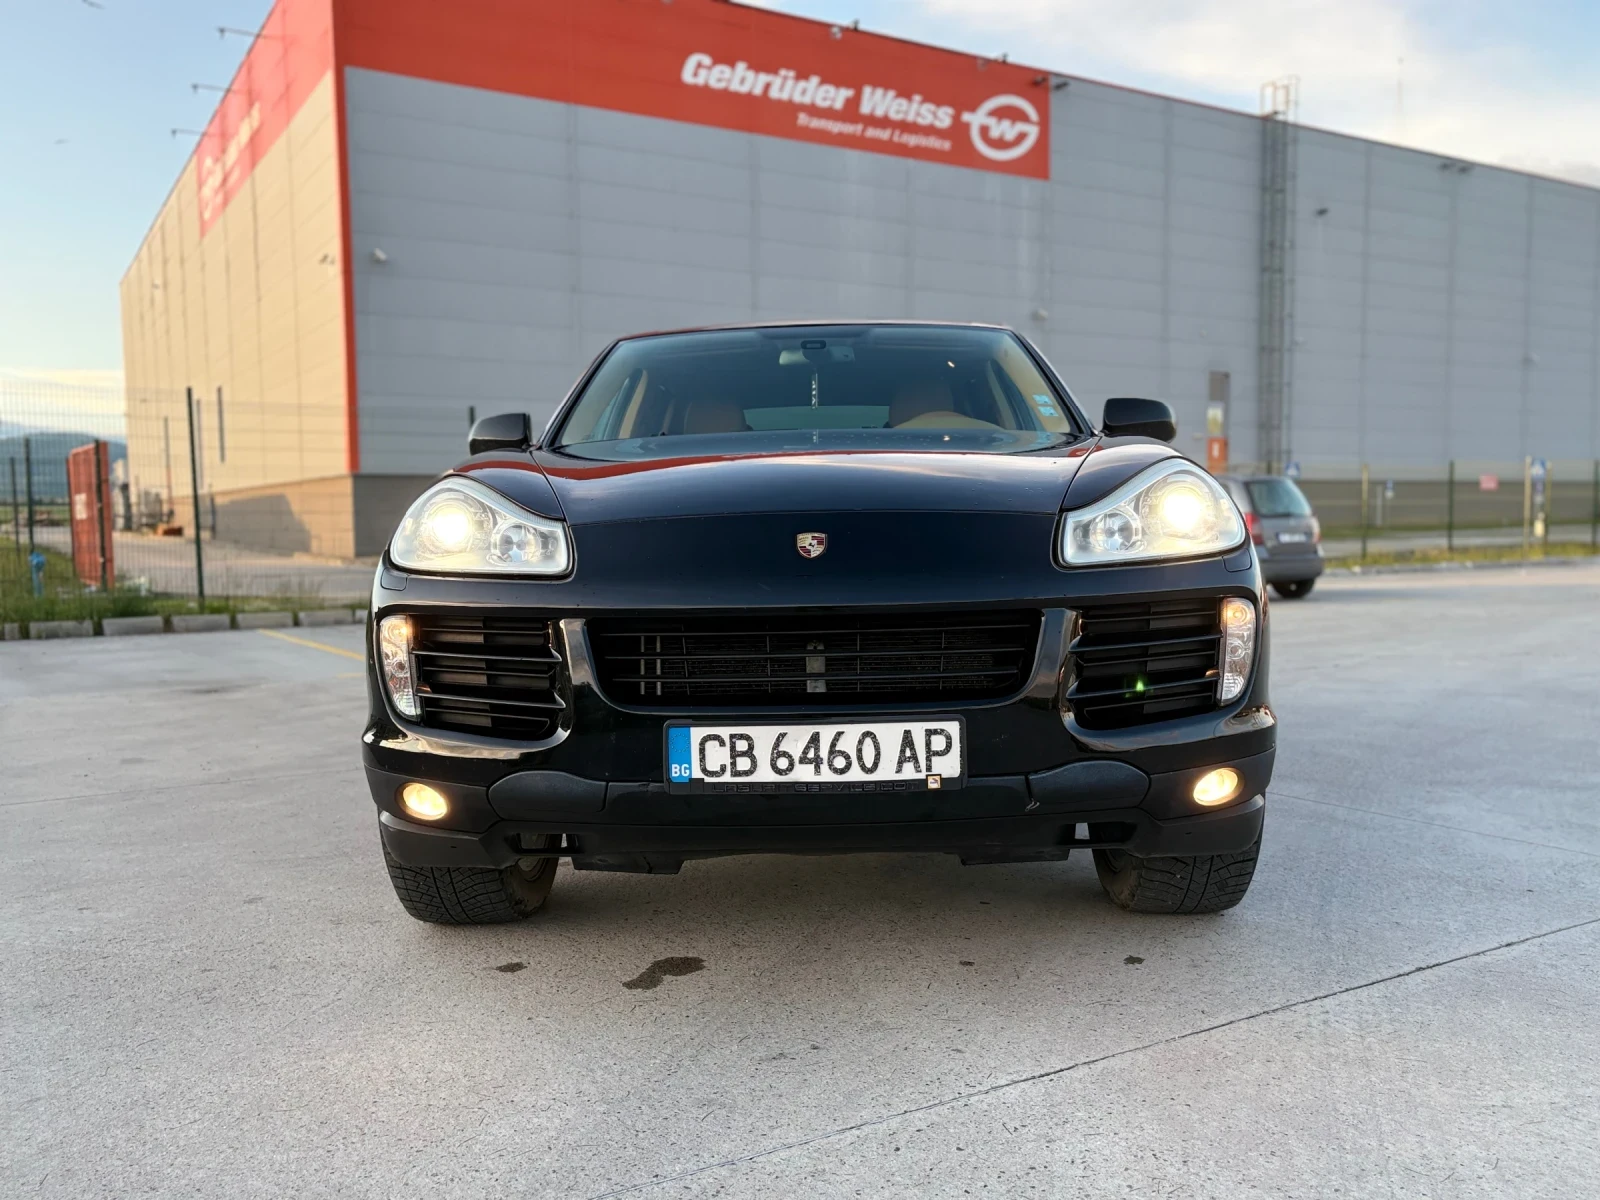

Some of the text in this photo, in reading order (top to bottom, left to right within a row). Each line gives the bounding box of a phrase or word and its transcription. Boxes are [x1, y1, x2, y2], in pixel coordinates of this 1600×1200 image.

[681, 52, 955, 129] Gebrüder Weiss
[796, 111, 953, 151] Transport and Logistics
[671, 763, 690, 777] BG
[698, 728, 953, 778] CB 6460 AP
